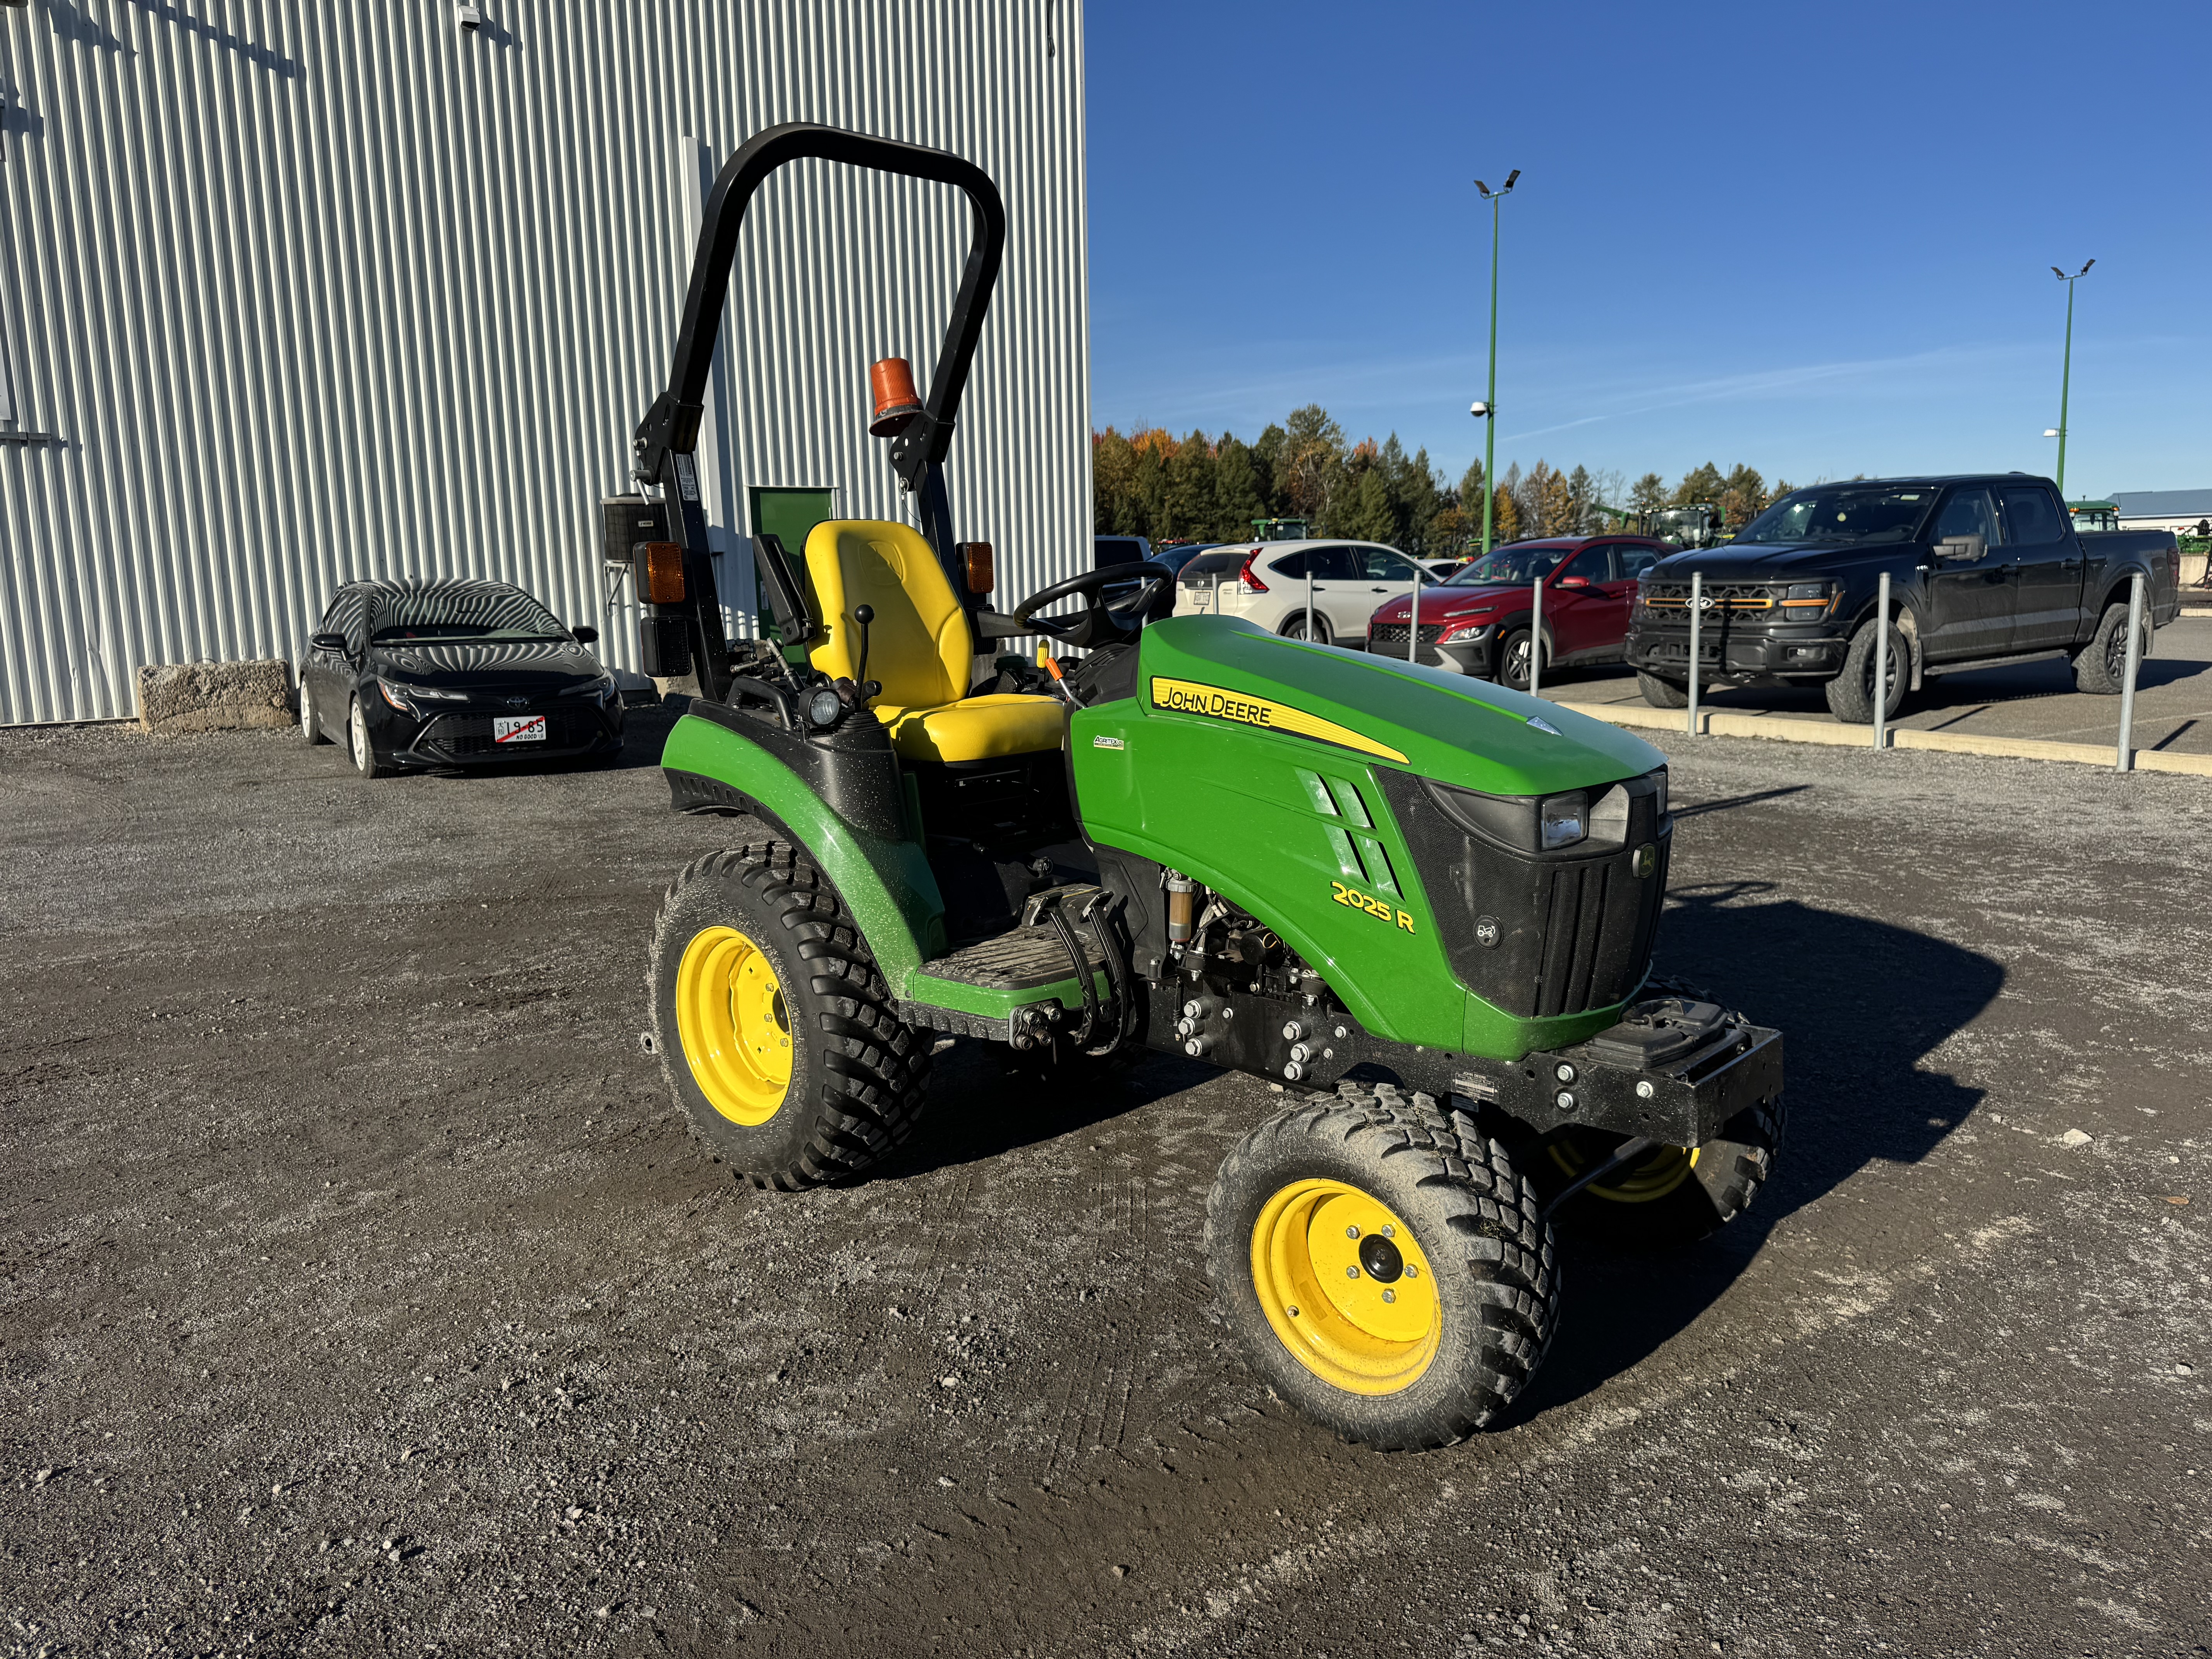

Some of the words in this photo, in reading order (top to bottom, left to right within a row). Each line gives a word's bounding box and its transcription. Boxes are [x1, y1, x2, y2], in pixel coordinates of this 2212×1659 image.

[1162, 687, 1207, 709] JOHN
[1210, 694, 1272, 724] DEERE
[1330, 881, 1392, 922] 2025
[1395, 909, 1416, 935] R
